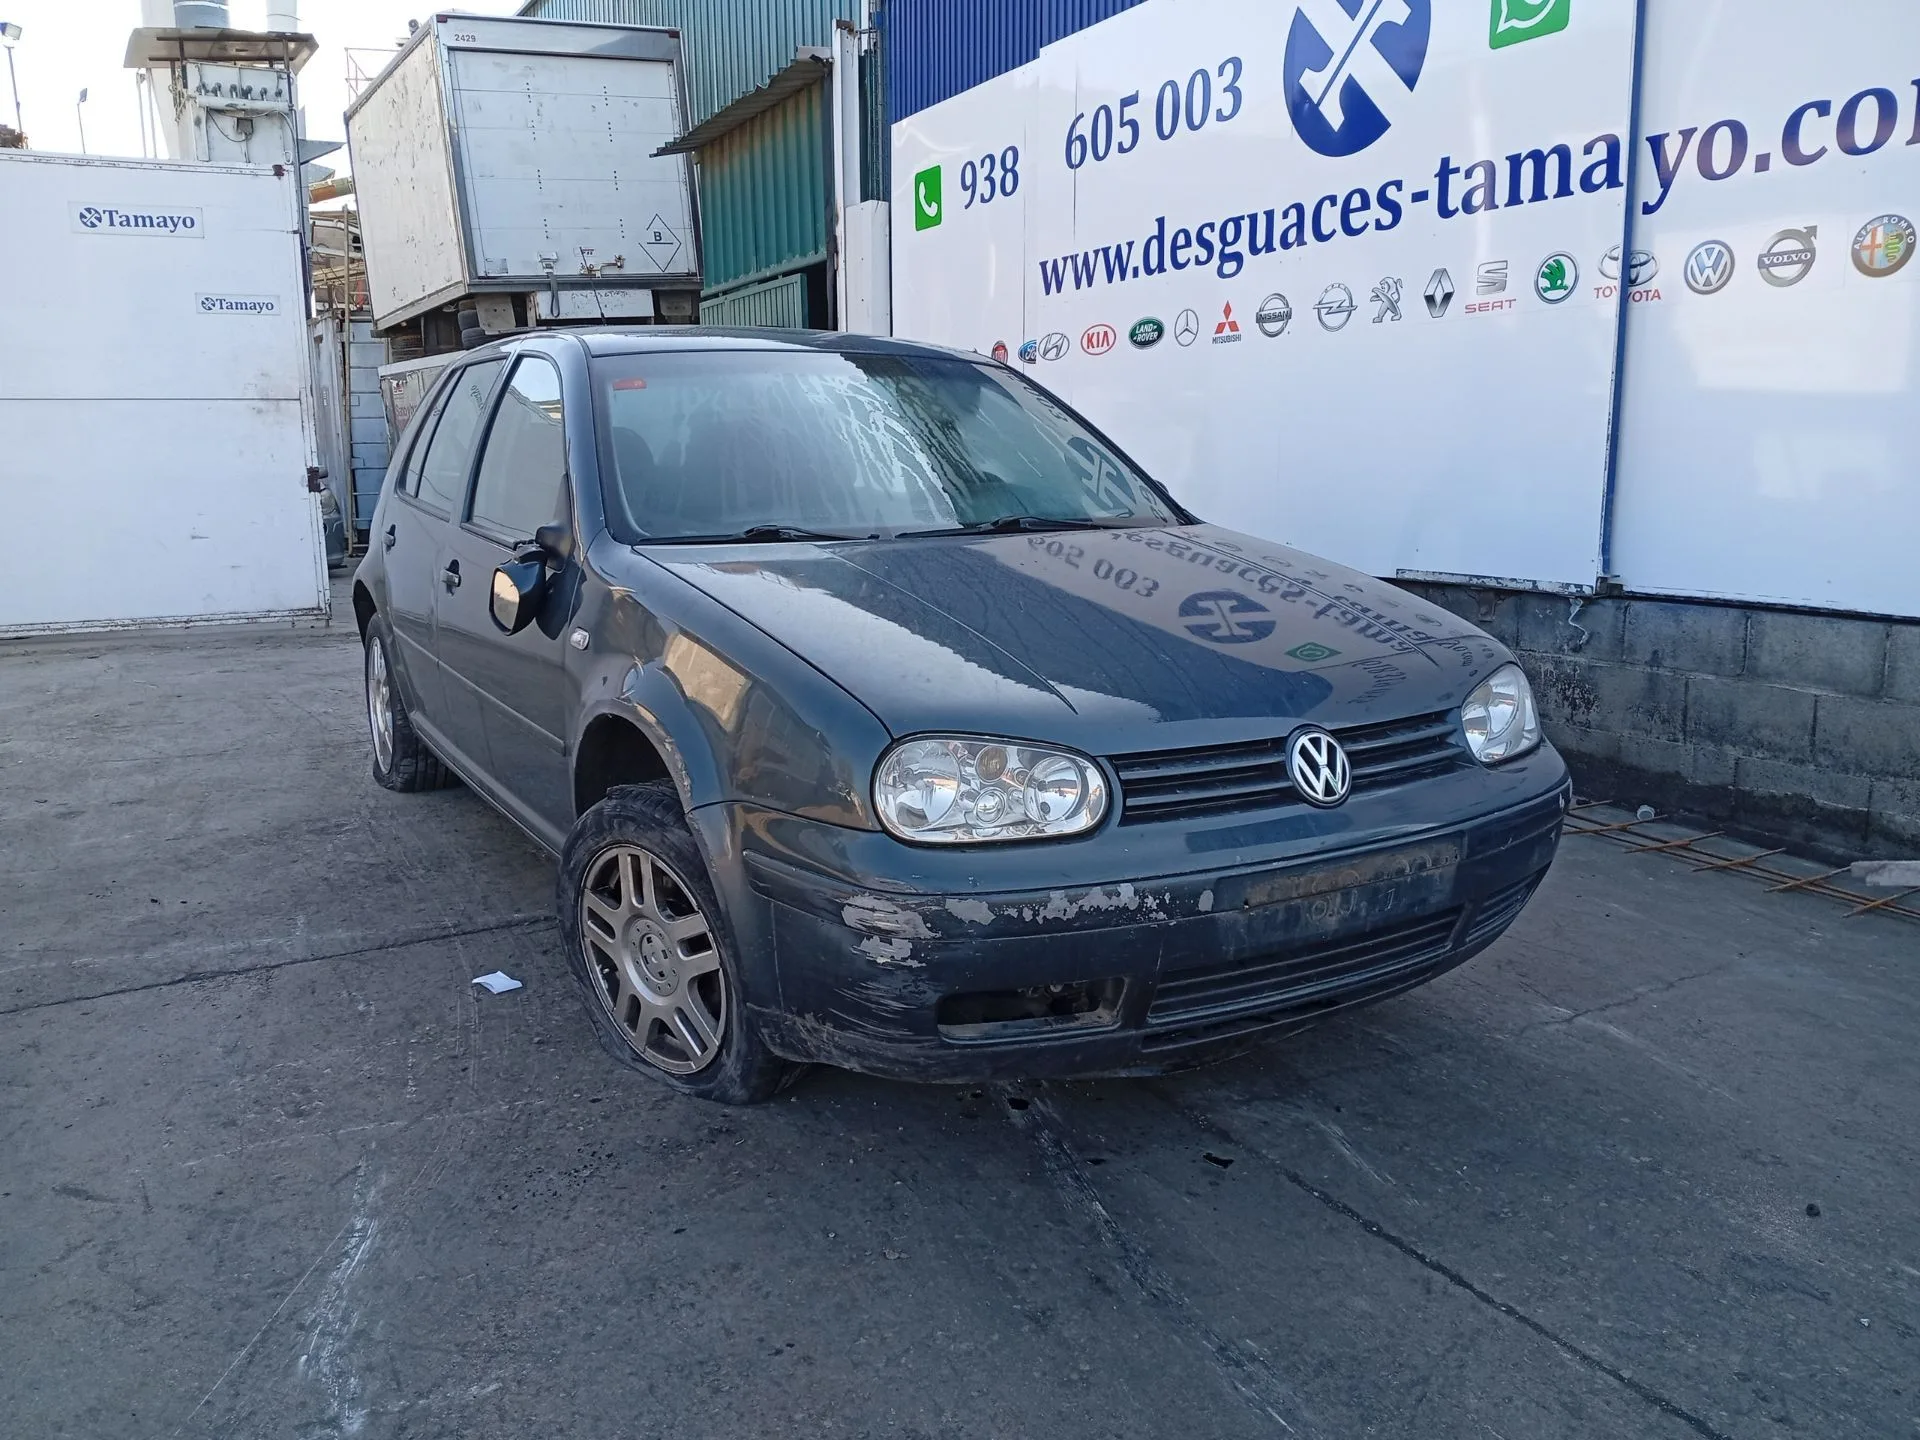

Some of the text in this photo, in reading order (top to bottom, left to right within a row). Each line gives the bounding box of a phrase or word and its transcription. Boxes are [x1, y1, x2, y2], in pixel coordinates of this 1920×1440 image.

[454, 33, 477, 43] 2429
[960, 57, 1243, 210] 938 605 003
[102, 209, 196, 233] Tamayo
[653, 231, 663, 242] B
[1853, 216, 1915, 250] ALFA ROMEO
[1761, 252, 1812, 265] VOLVO
[215, 298, 275, 314] Tamayo
[1464, 298, 1517, 314] SEAT
[1258, 309, 1290, 322] NISSAN
[1135, 323, 1154, 334] LAND
[1086, 330, 1111, 350] KIA
[1136, 331, 1159, 342] ROVER
[1212, 333, 1242, 345] MITSUBISHI
